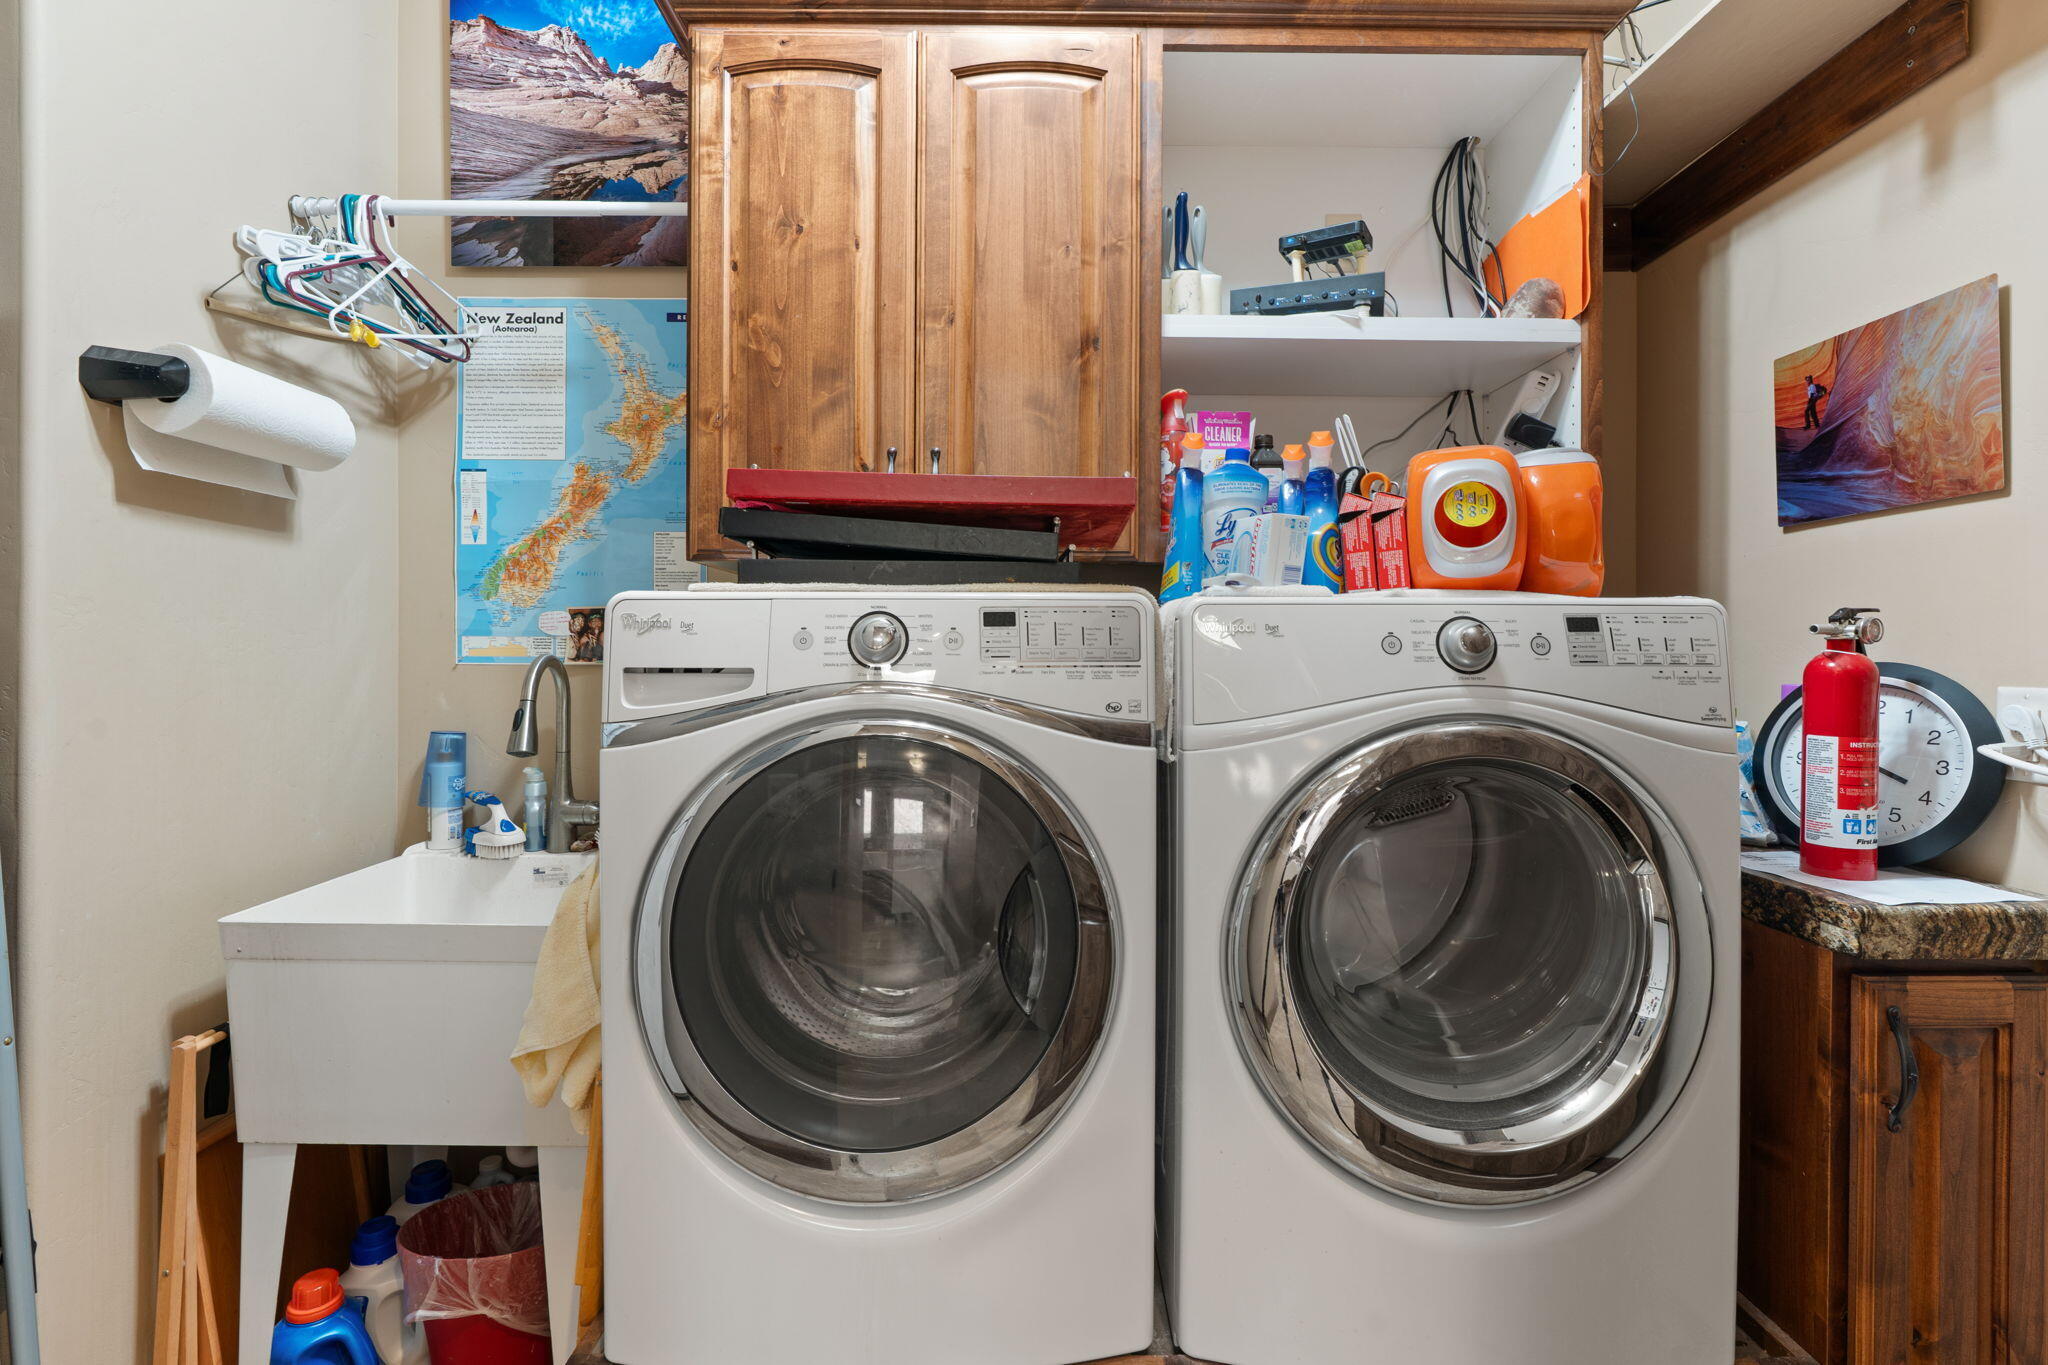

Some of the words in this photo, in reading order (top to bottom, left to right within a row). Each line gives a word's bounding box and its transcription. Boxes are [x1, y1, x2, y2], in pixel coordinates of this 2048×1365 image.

[466, 312, 500, 324] New
[506, 312, 564, 324] Zealand
[492, 325, 538, 334] (Aotearoa)
[1204, 426, 1242, 442] CLEANER
[621, 613, 672, 635] Whirlpool
[680, 620, 694, 630] Duet
[1204, 618, 1256, 639] Whirlpool
[1264, 623, 1280, 632] Duet
[1880, 700, 1886, 714] 2
[1905, 709, 1913, 724] 1
[1927, 730, 1941, 746] 2
[1935, 760, 1950, 776] 3
[1918, 790, 1932, 806] 4
[1888, 807, 1902, 822] 5
